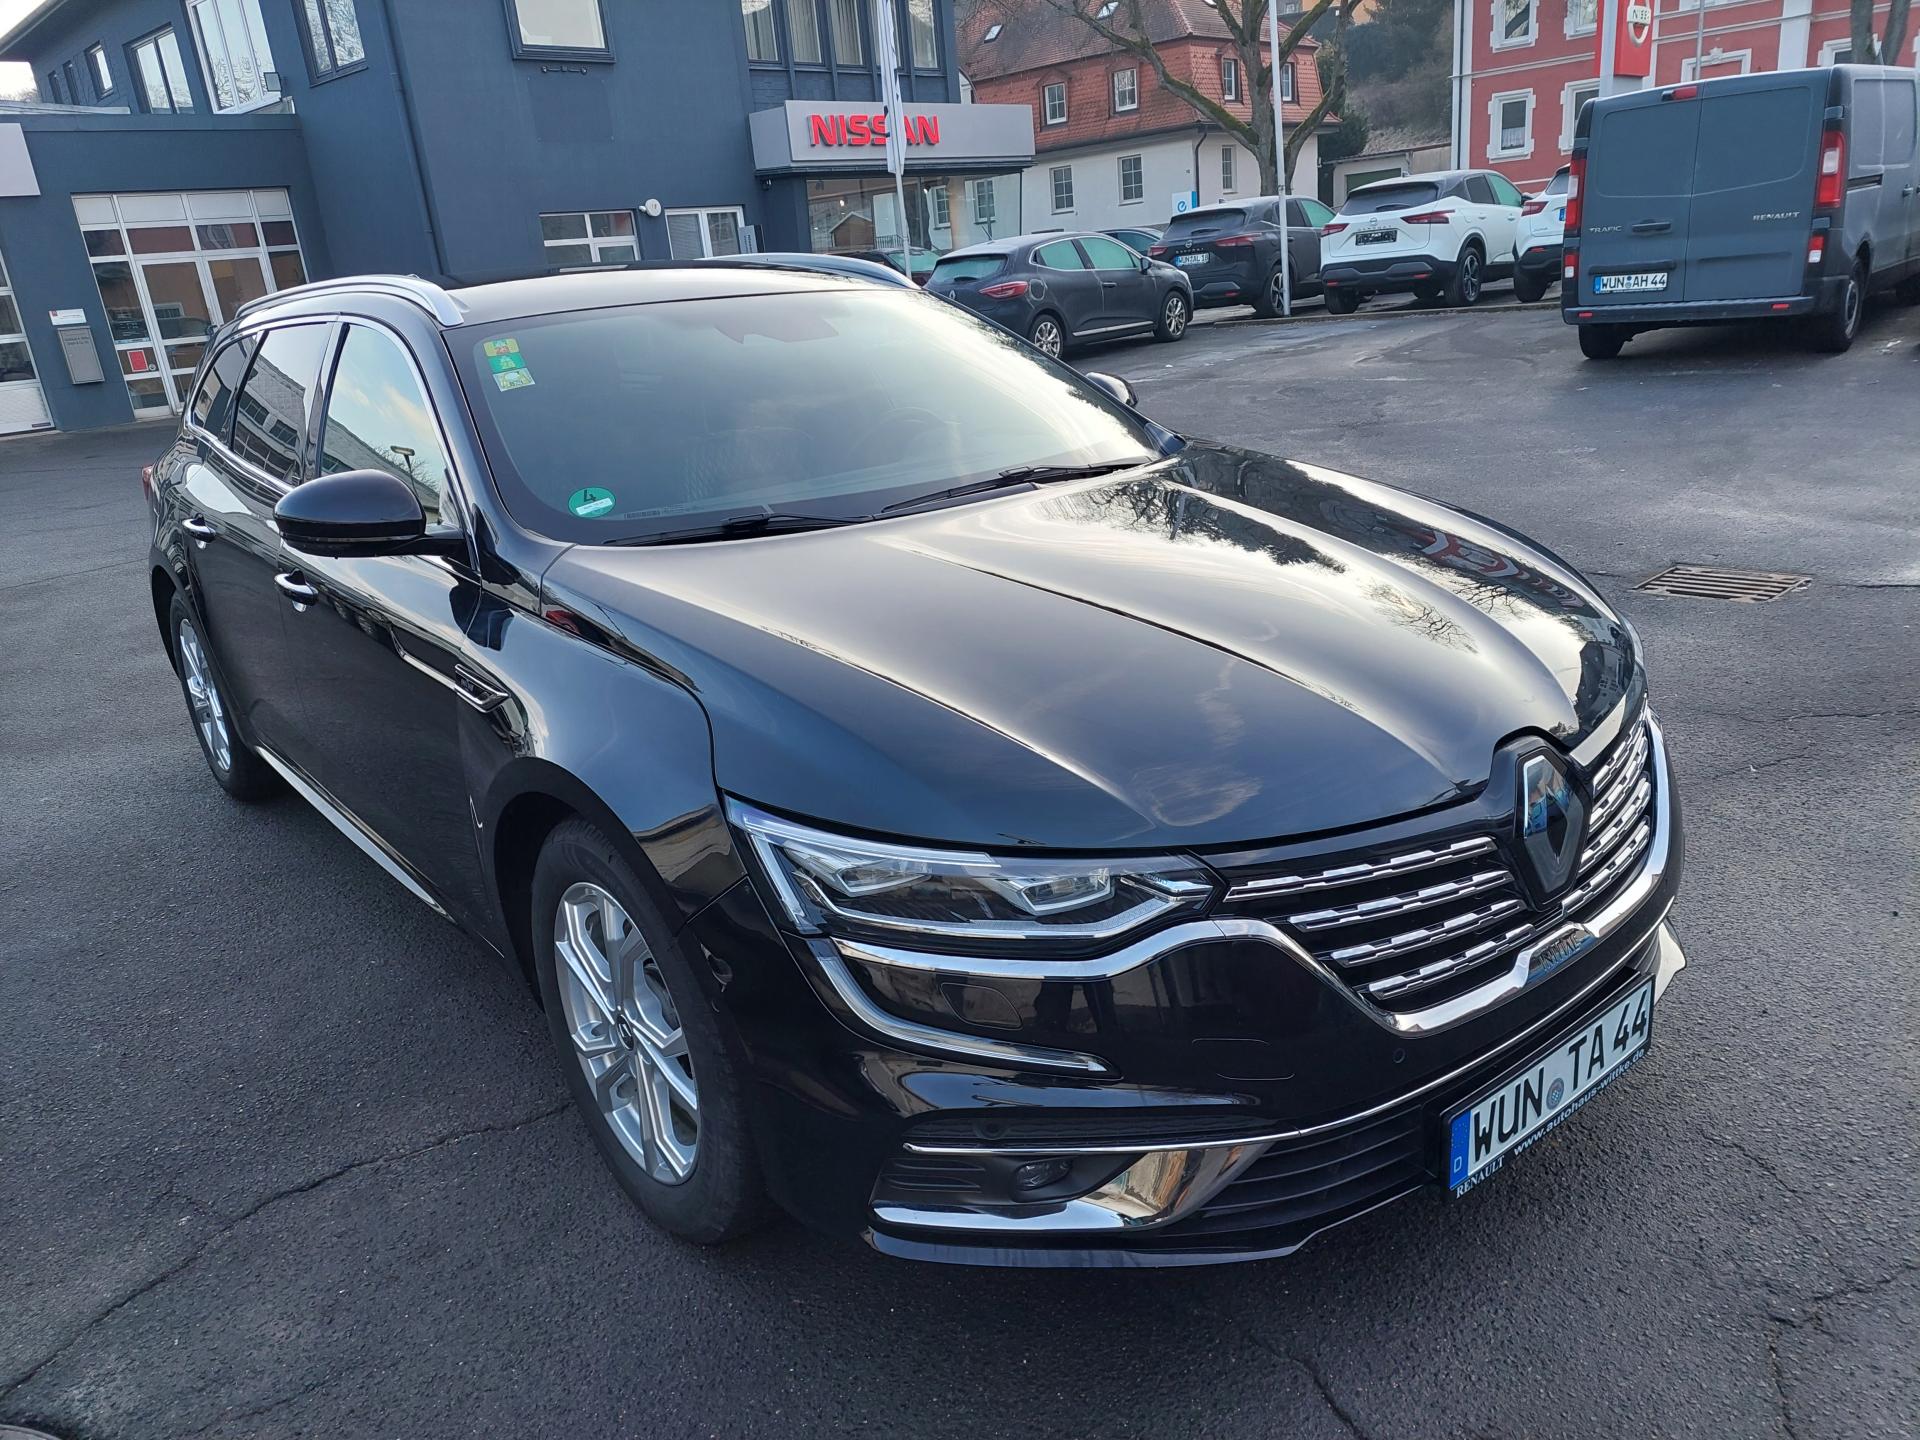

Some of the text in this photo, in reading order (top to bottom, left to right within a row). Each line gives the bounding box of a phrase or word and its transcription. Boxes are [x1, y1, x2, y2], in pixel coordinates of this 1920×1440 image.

[1589, 225, 1622, 233] TRAFIC
[1602, 274, 1666, 289] WUN AH 44
[1471, 988, 1649, 1164] WUN TA 44
[1456, 1048, 1645, 1199] RENAULT www.autohaus-wittke.de
[1453, 1156, 1463, 1174] D
